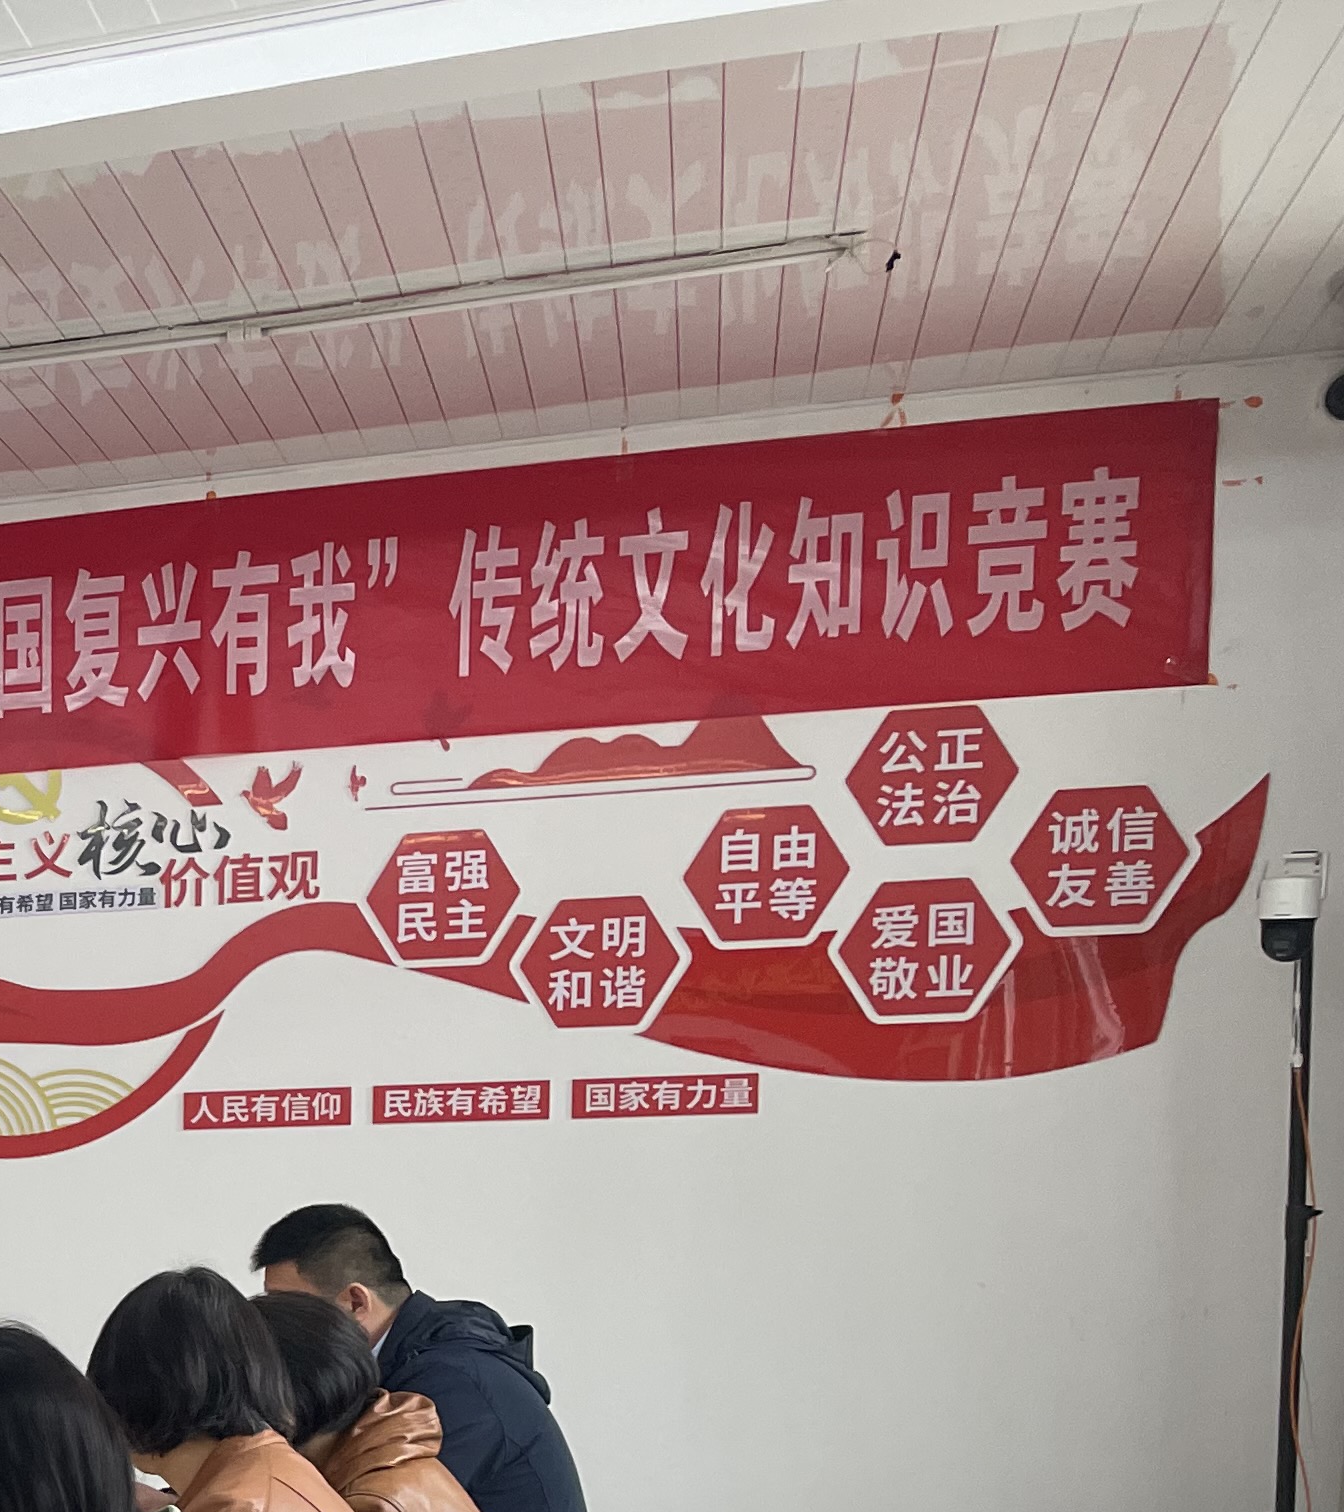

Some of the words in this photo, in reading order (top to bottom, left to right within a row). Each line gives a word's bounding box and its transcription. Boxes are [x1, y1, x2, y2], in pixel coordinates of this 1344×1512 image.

[449, 467, 1141, 679] 传统文化知识竞赛
[878, 727, 984, 774] 公正
[877, 779, 982, 827] 法治
[720, 825, 817, 873] 自由
[1047, 805, 1158, 855] 诚信
[396, 849, 489, 895] 富强
[1046, 859, 1156, 909] 友善
[59, 888, 157, 910] 国家有力量
[396, 898, 488, 944] 民主
[715, 876, 817, 924] 平等
[549, 915, 647, 960] 文明
[871, 901, 976, 949] 爱国
[548, 965, 647, 1011] 和谐
[869, 954, 975, 1000] 敬业
[190, 1092, 342, 1124] 人民有信仰
[383, 1085, 542, 1117] 民族有希望
[585, 1078, 753, 1112] 国家有力量
